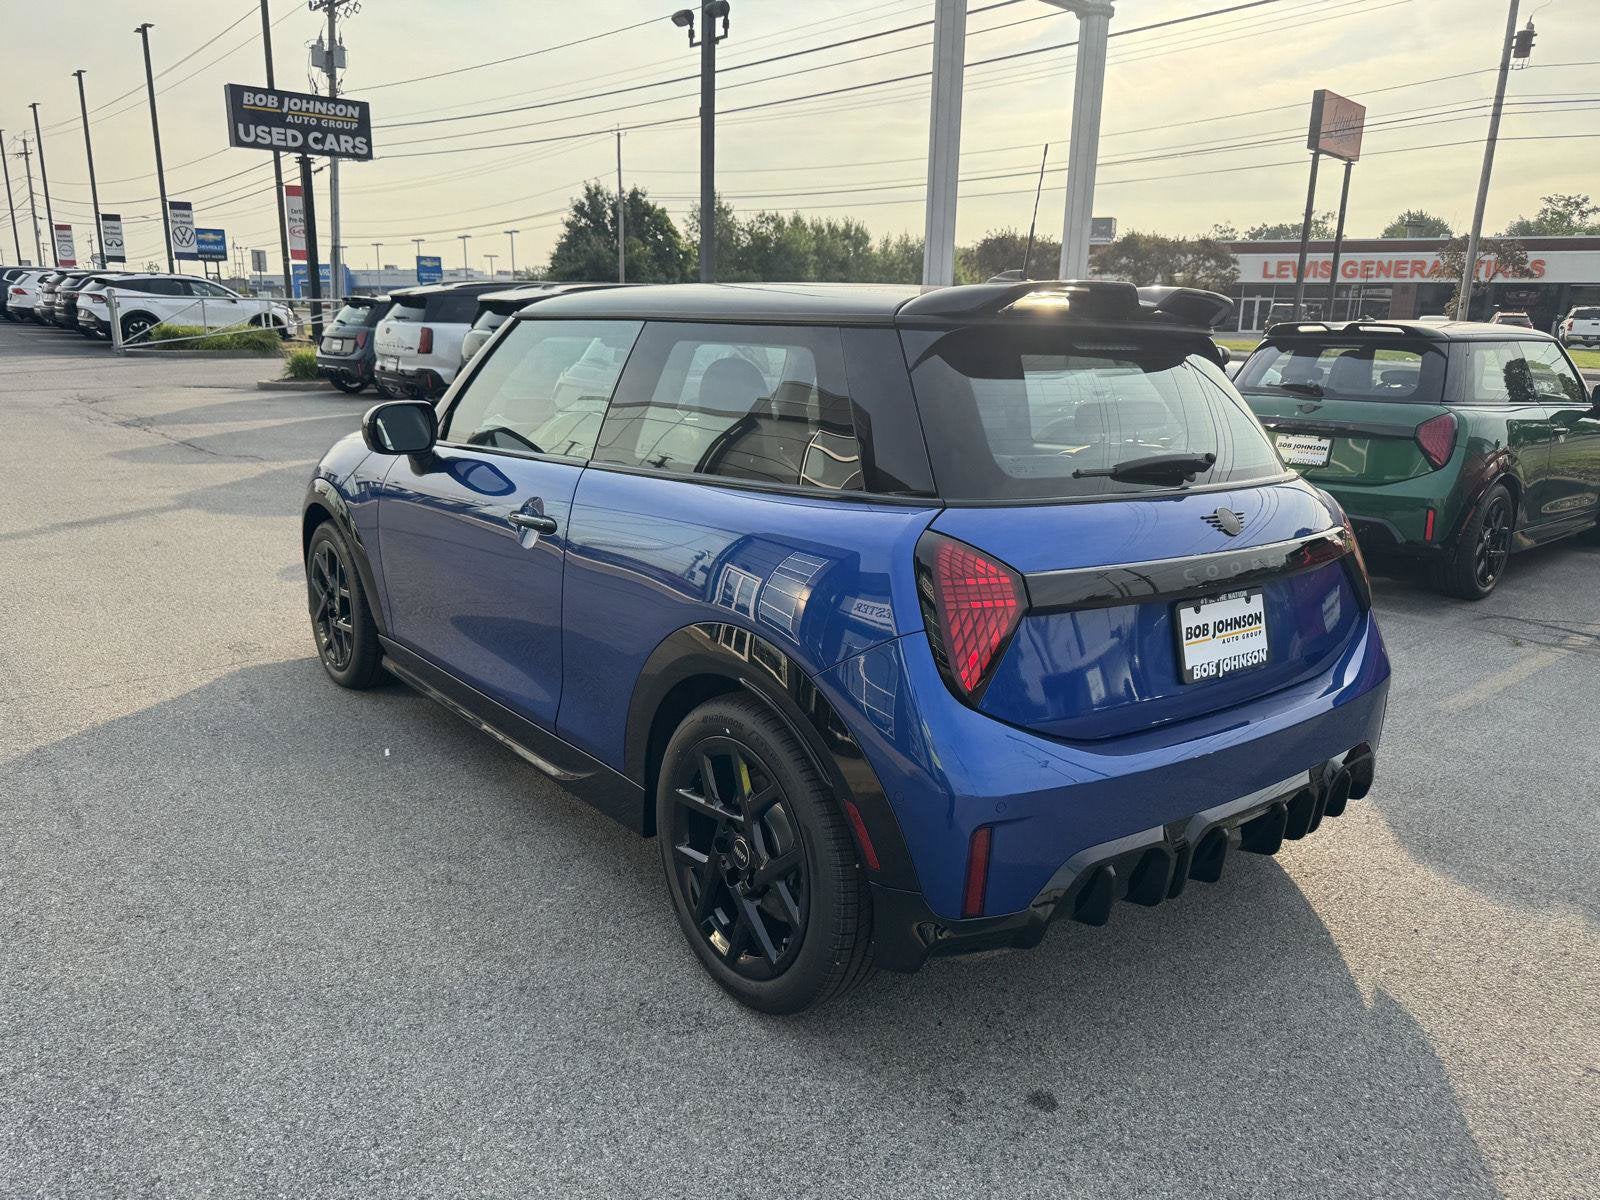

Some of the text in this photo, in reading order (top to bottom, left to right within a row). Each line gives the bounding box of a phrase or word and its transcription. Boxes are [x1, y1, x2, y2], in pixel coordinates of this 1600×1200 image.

[243, 91, 360, 118] BOB JOHNSON
[286, 115, 358, 130] AUTO GROUP
[237, 123, 369, 155] USED CARS
[1341, 259, 1455, 279] GENERA
[1473, 259, 1546, 279] TIRS
[1293, 443, 1328, 452] JOHNSON
[1185, 611, 1262, 641] BOB JOHNSON
[1221, 630, 1262, 645] AUTO GROUP
[1193, 648, 1267, 680] BOB JOHNSON
